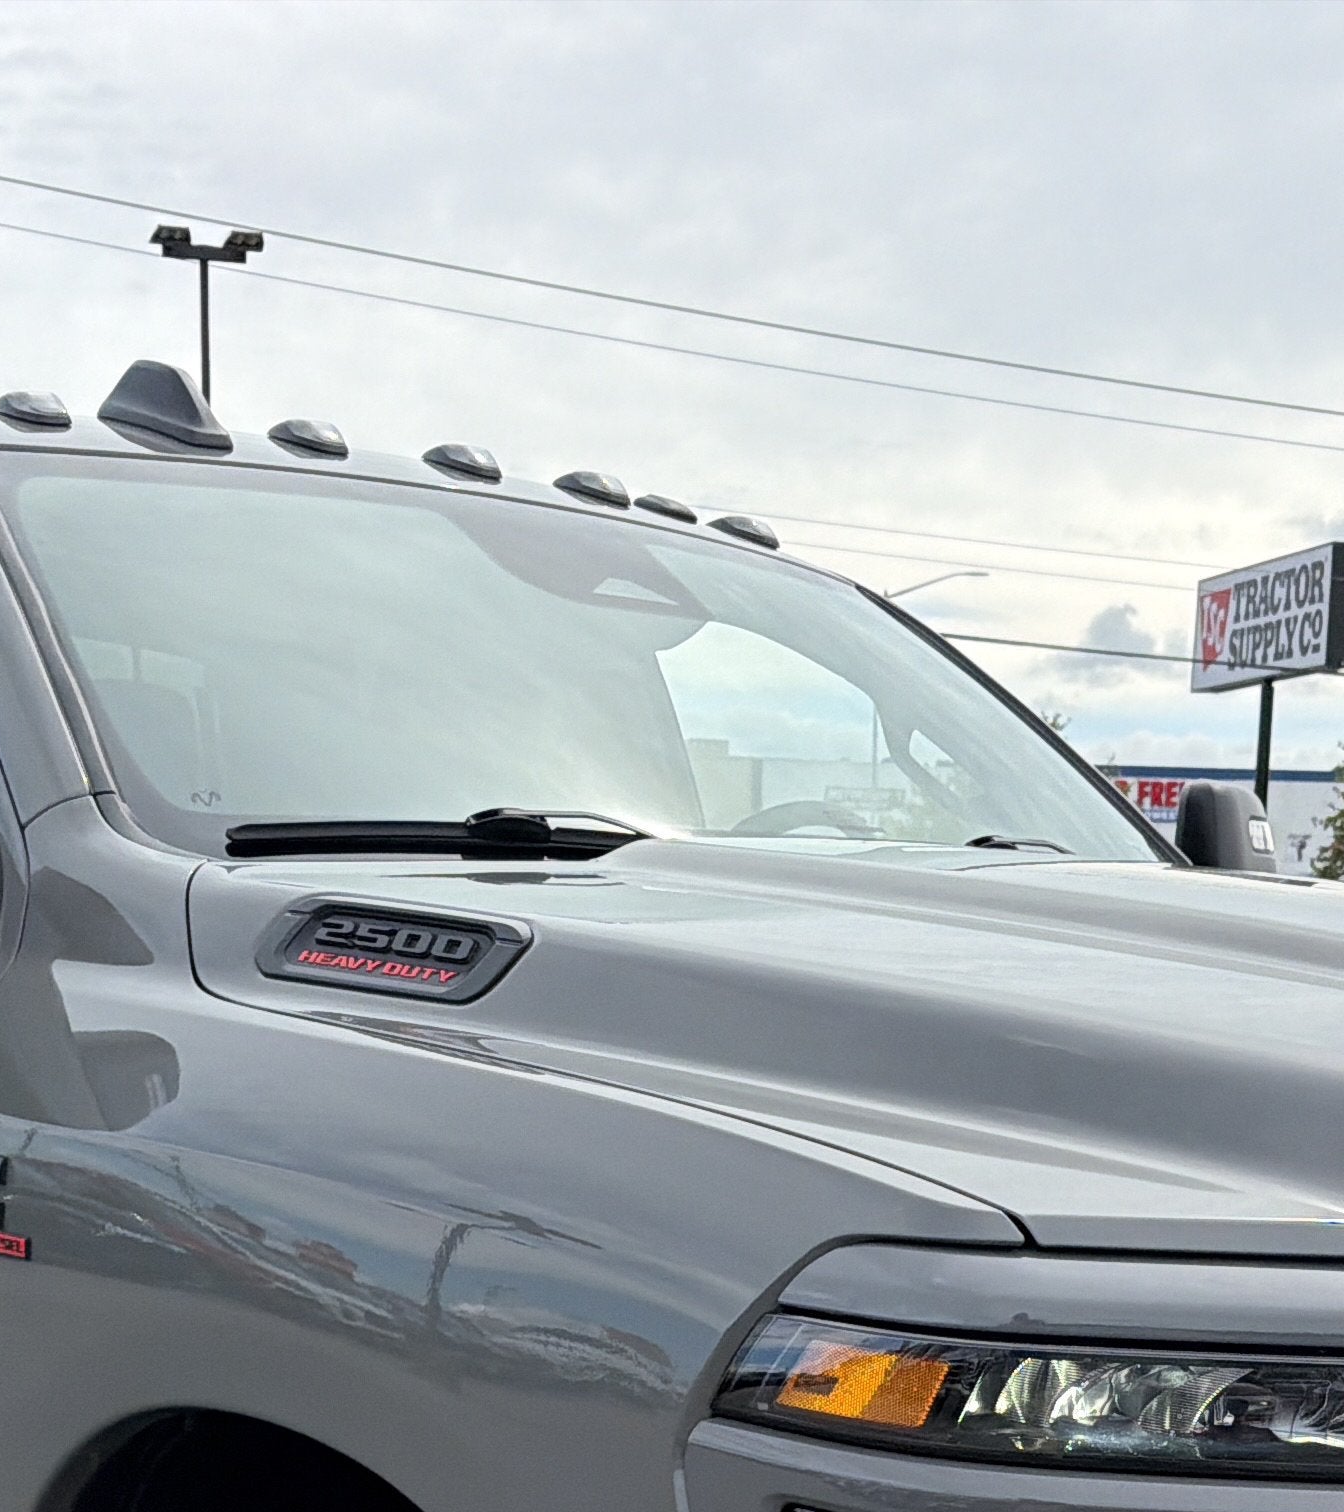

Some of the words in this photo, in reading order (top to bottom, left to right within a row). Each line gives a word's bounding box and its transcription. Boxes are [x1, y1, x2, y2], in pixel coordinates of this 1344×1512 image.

[1233, 560, 1325, 624] TRACTOR
[1228, 615, 1299, 671] SUPPLY
[1138, 781, 1185, 808] FRE
[314, 918, 479, 964] 2500
[297, 949, 383, 974] HEAVY
[382, 962, 457, 984] DUTY
